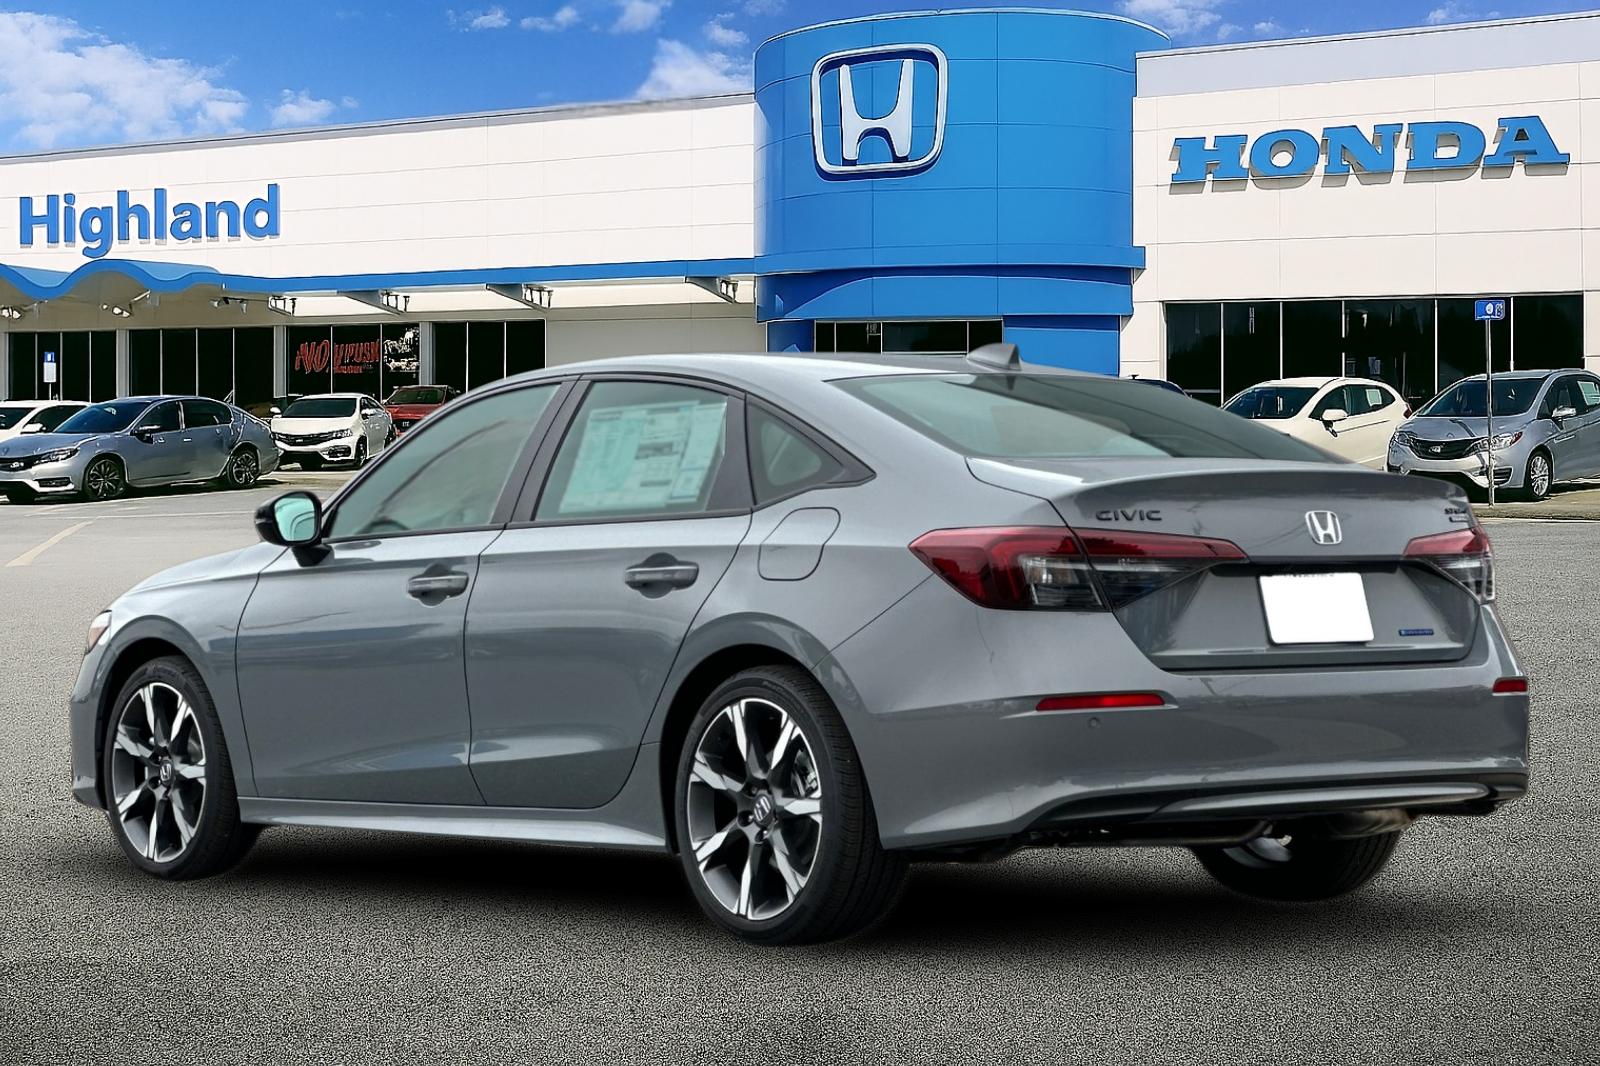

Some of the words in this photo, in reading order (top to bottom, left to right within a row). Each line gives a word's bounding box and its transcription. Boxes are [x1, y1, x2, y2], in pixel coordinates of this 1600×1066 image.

[1171, 115, 1570, 183] HONDA
[20, 183, 280, 257] Highland
[1096, 509, 1162, 521] CIVIC
